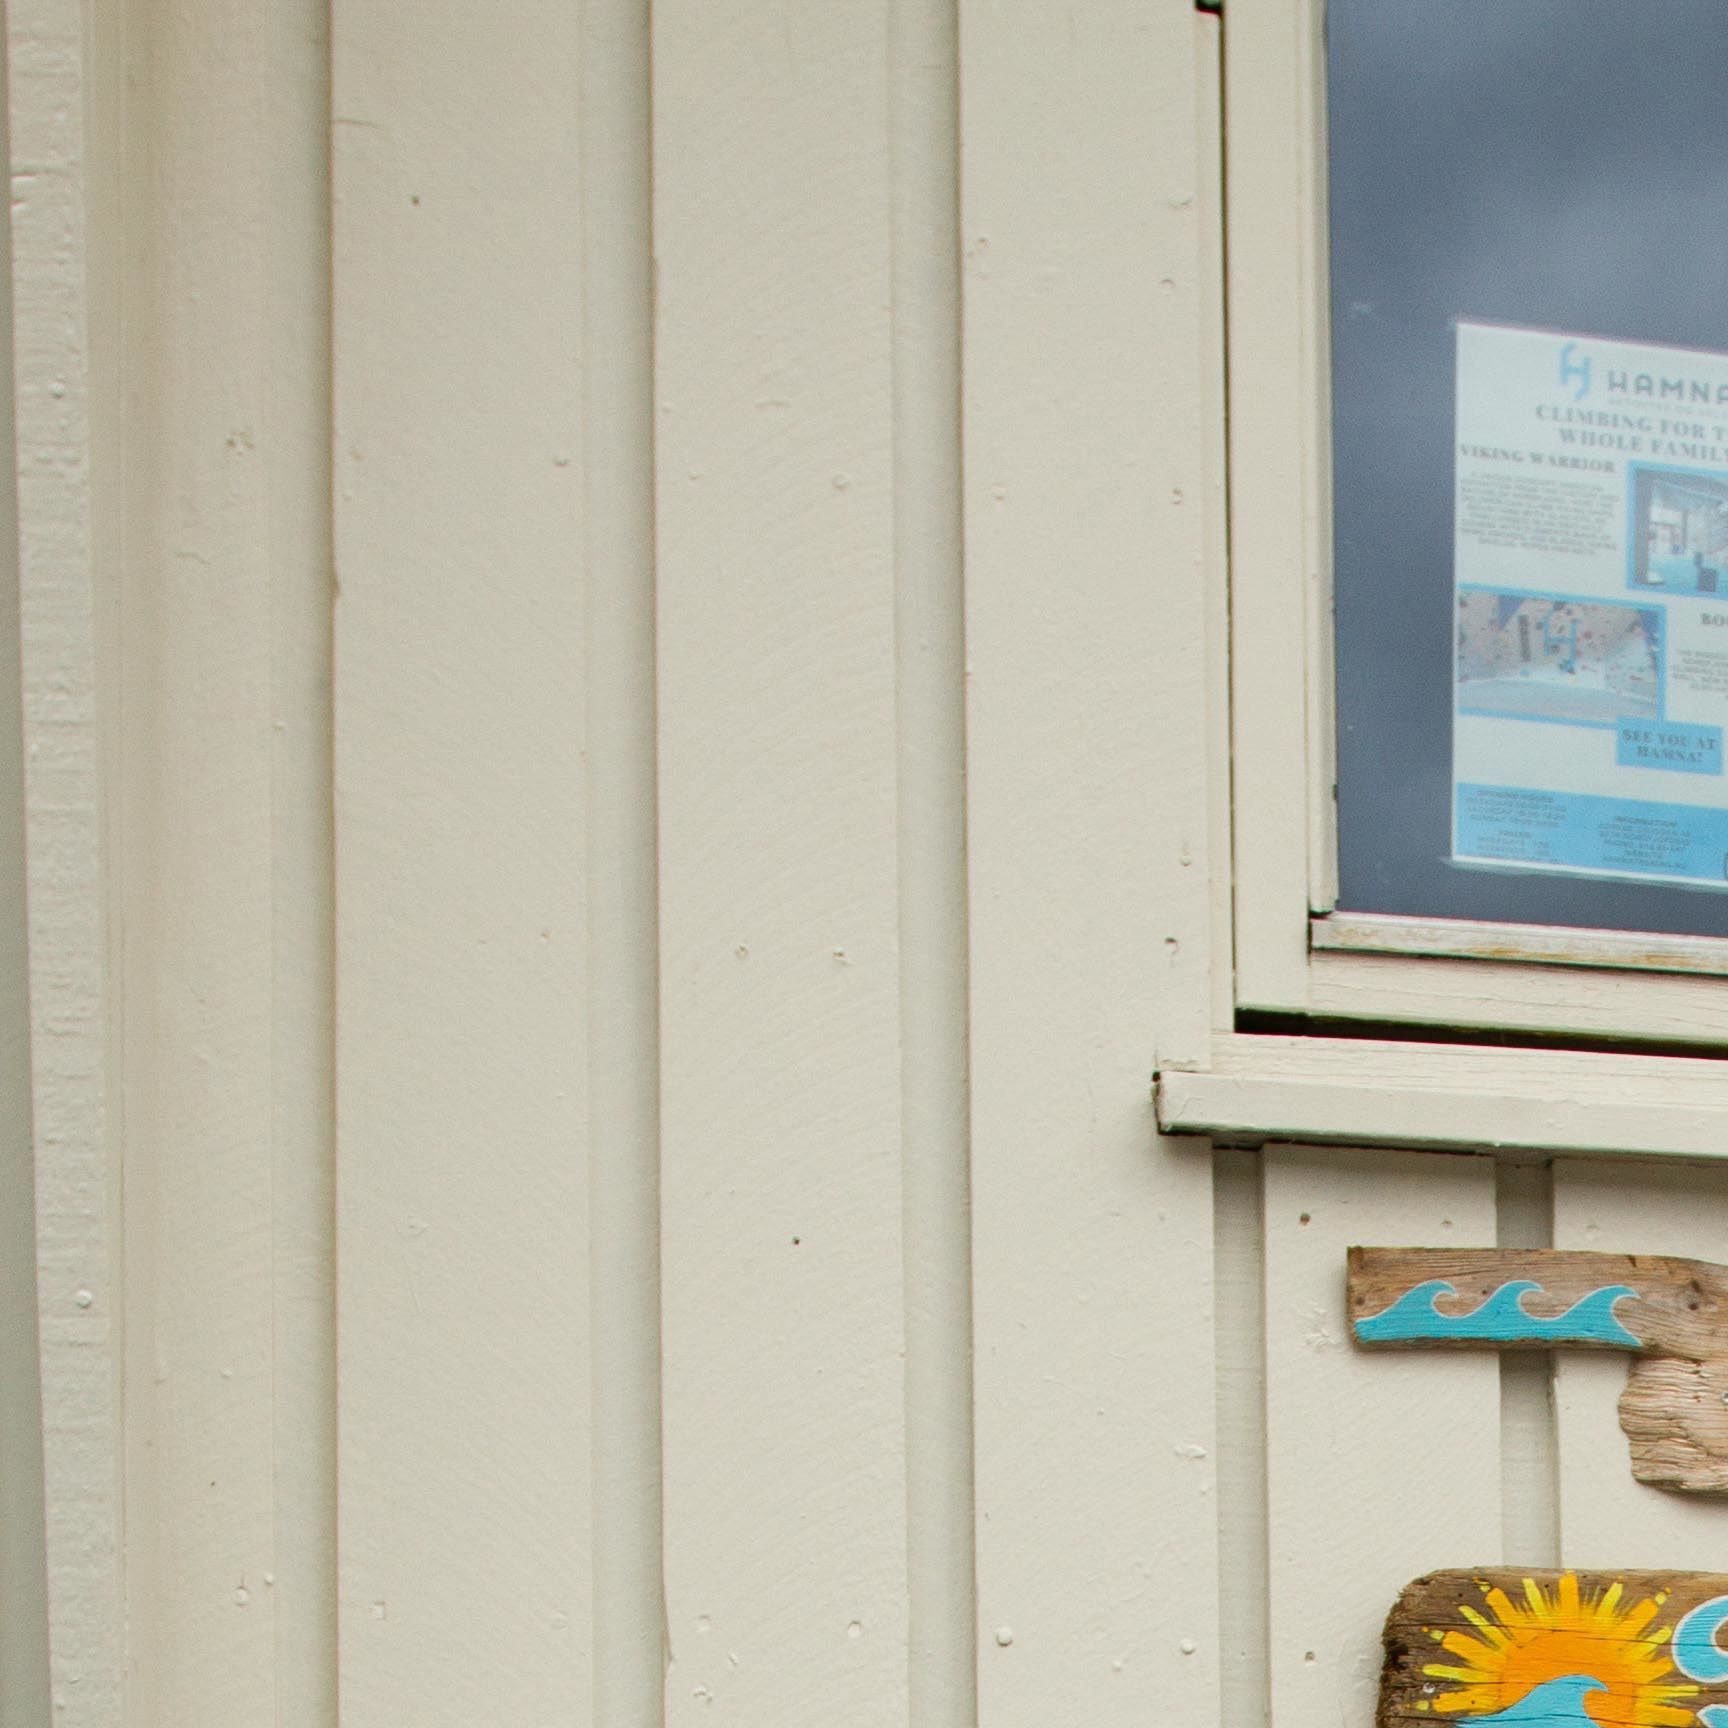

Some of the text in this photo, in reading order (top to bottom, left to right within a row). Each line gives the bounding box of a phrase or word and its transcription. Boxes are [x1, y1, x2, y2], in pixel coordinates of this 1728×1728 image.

[1535, 404, 1651, 433] CLIMBING
[1660, 418, 1704, 440] FOR
[1559, 427, 1643, 452] WHOLE
[1622, 729, 1716, 751] SEE YOU AT
